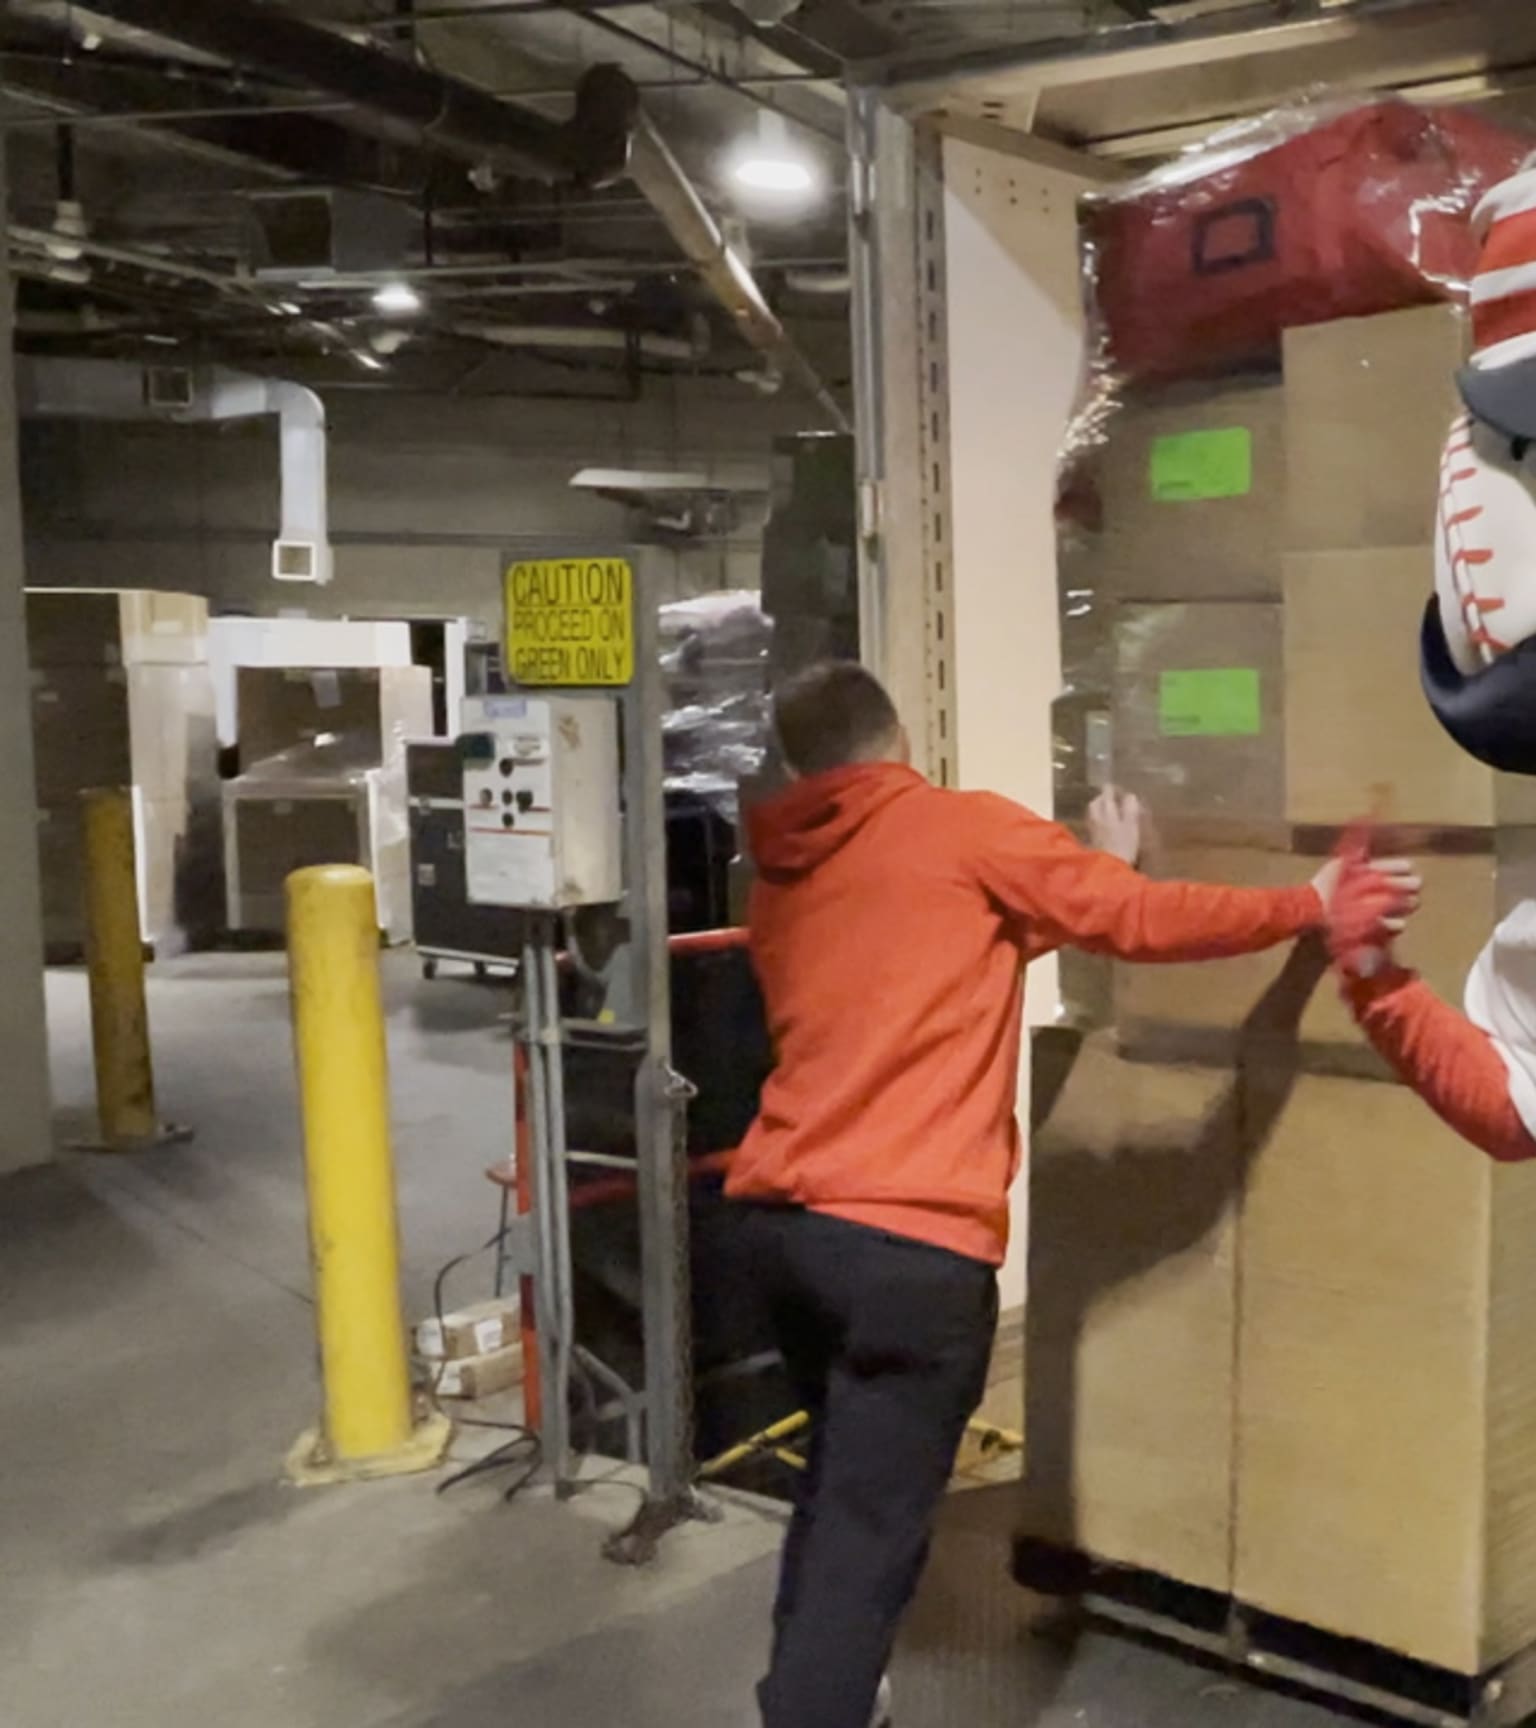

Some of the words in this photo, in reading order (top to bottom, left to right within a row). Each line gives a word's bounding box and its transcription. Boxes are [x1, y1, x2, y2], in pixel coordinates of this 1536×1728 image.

[512, 562, 624, 605] CAUTION
[512, 608, 593, 643] PROCEED
[600, 607, 625, 641] ON
[514, 646, 570, 680] GREEN
[577, 645, 625, 681] ONLY
